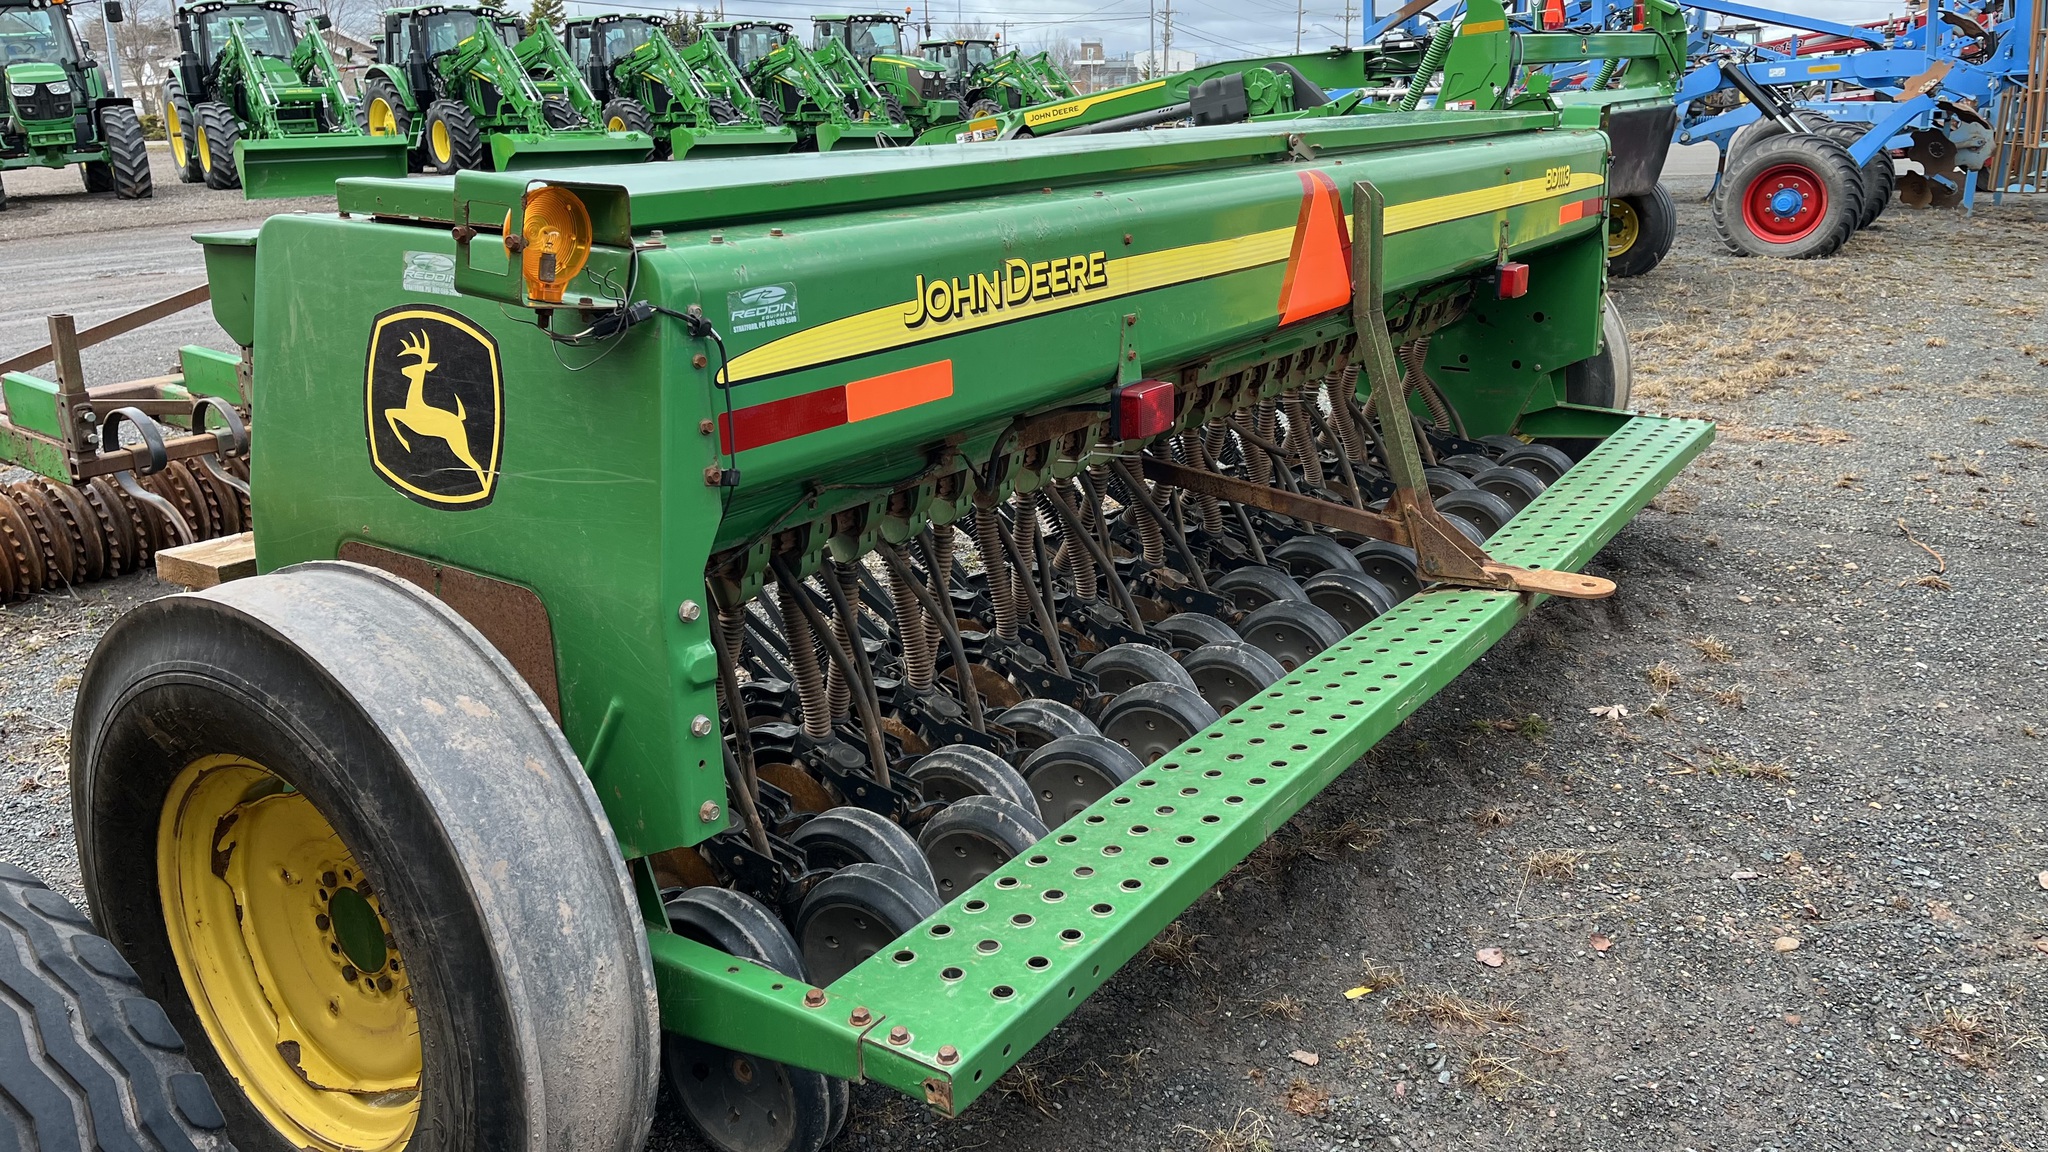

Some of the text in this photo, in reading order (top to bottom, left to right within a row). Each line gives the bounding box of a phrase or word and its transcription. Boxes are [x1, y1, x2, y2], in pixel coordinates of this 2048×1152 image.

[1030, 105, 1079, 121] JOHN DEERE
[904, 251, 1107, 327] JOHN DEERE
[731, 302, 795, 321] REDDIN
[762, 311, 796, 320] EQUIPMENT
